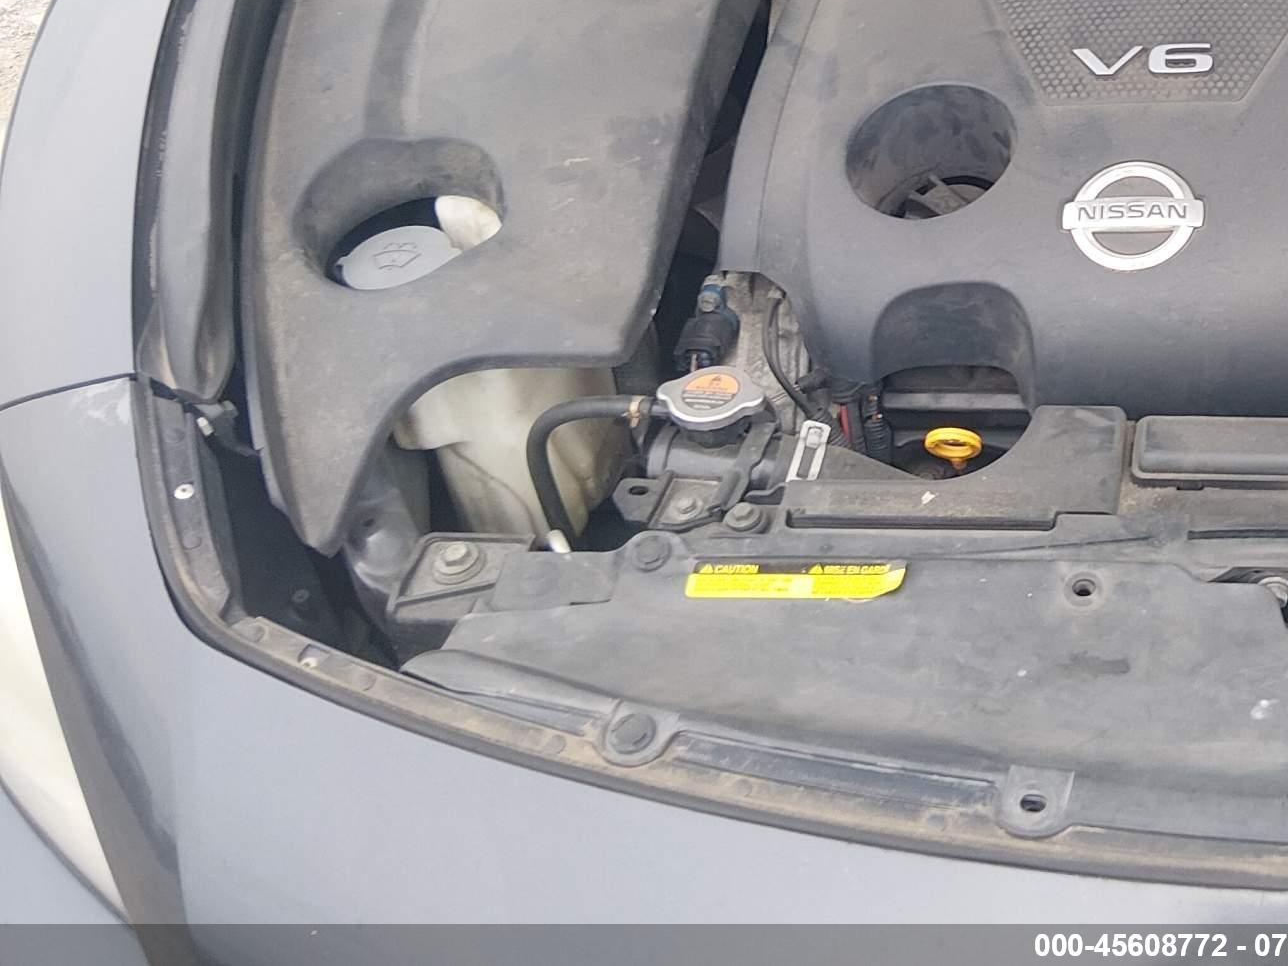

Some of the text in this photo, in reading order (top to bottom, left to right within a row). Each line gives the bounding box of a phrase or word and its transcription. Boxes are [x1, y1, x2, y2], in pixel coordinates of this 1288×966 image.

[1071, 43, 1214, 76] V6
[1077, 203, 1188, 222] NISSAN
[714, 564, 760, 574] CAUTION
